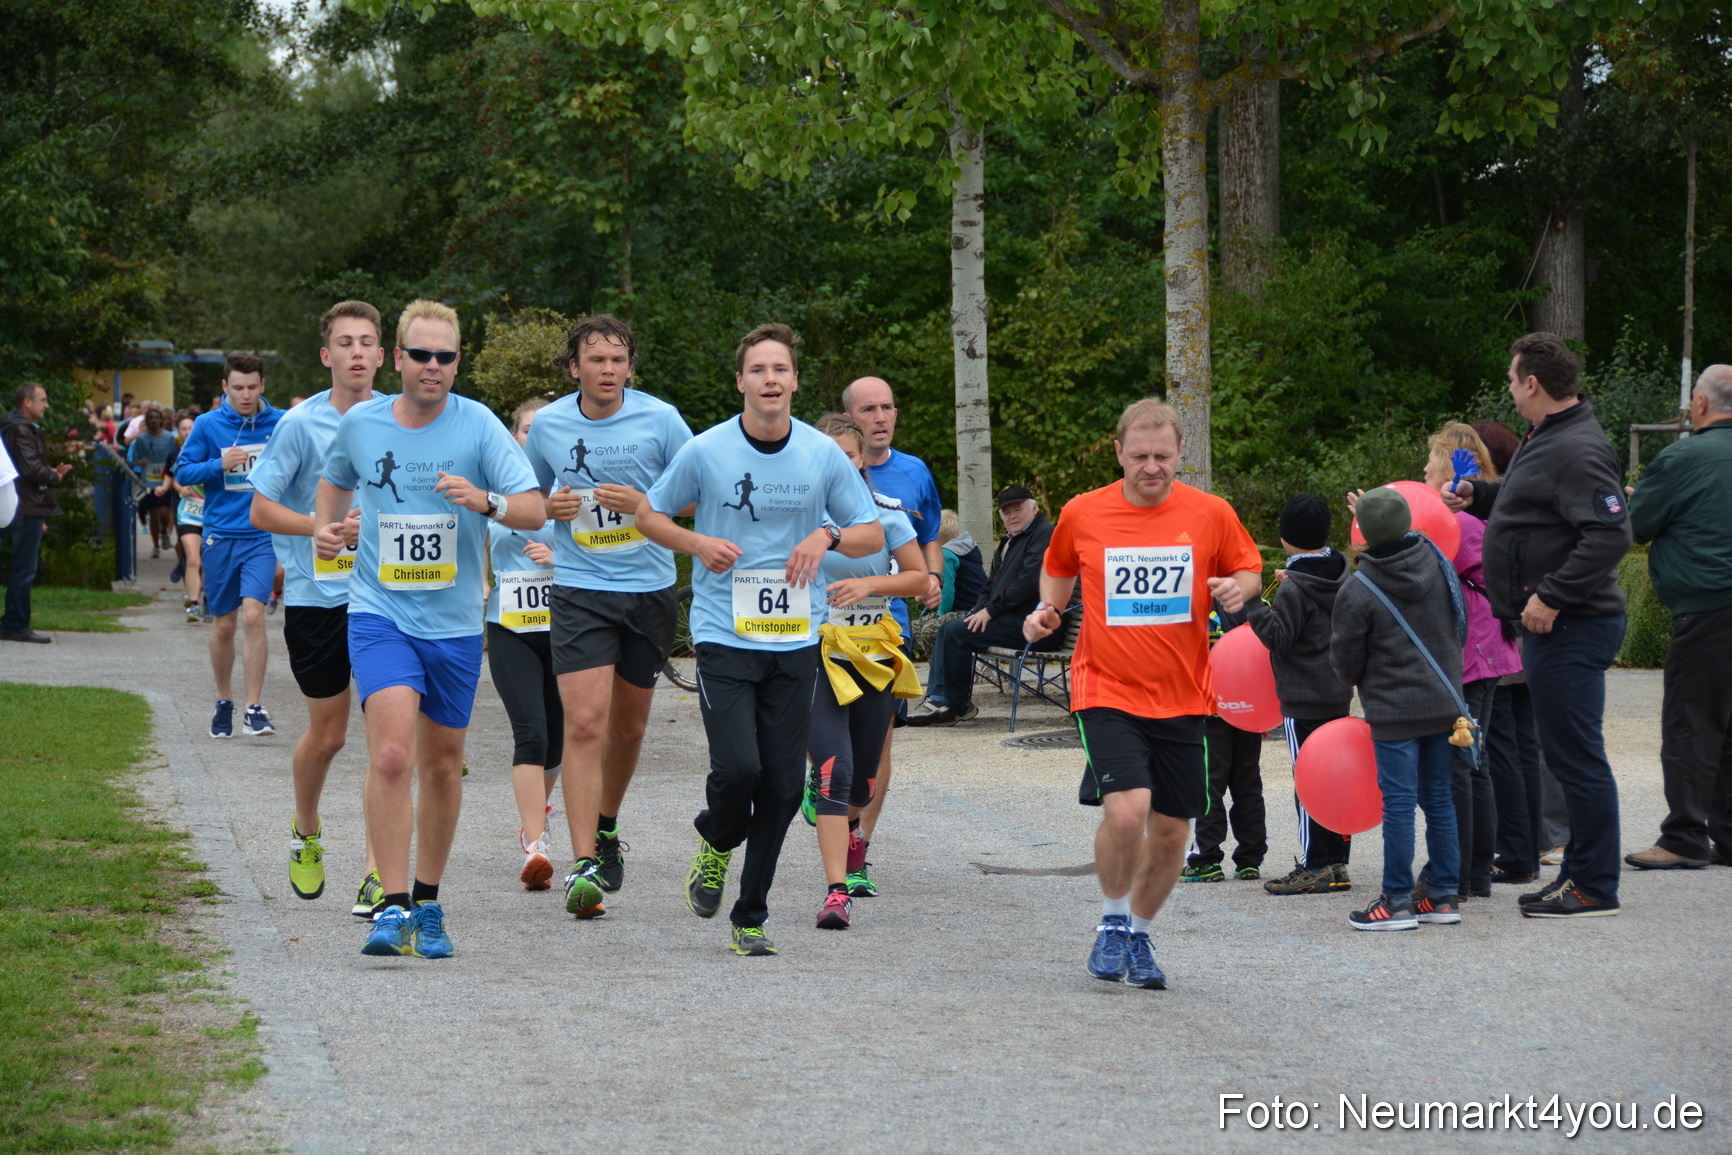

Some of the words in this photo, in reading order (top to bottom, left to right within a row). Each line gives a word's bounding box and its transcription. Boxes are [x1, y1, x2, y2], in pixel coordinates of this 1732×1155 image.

[595, 446, 620, 456] GYM
[622, 444, 639, 454] HIP
[405, 463, 433, 473] GYM
[436, 460, 455, 472] HIP
[763, 483, 790, 494] GYM
[793, 484, 810, 494] HIP
[768, 498, 801, 506] P-Seminar
[380, 521, 403, 530] PARTL
[405, 522, 444, 530] Neumarkt
[589, 532, 631, 546] Matthias
[393, 533, 442, 562] 183
[337, 559, 354, 569] Ste
[1138, 554, 1178, 562] Neumarkt
[394, 569, 441, 580] Christian
[522, 575, 554, 583] Neumarkt
[1115, 566, 1185, 595] 2827
[513, 584, 552, 608] 108
[758, 587, 790, 615] 64
[1132, 602, 1168, 614] Stefan
[521, 614, 547, 625] Tanja
[744, 621, 801, 634] Christopher
